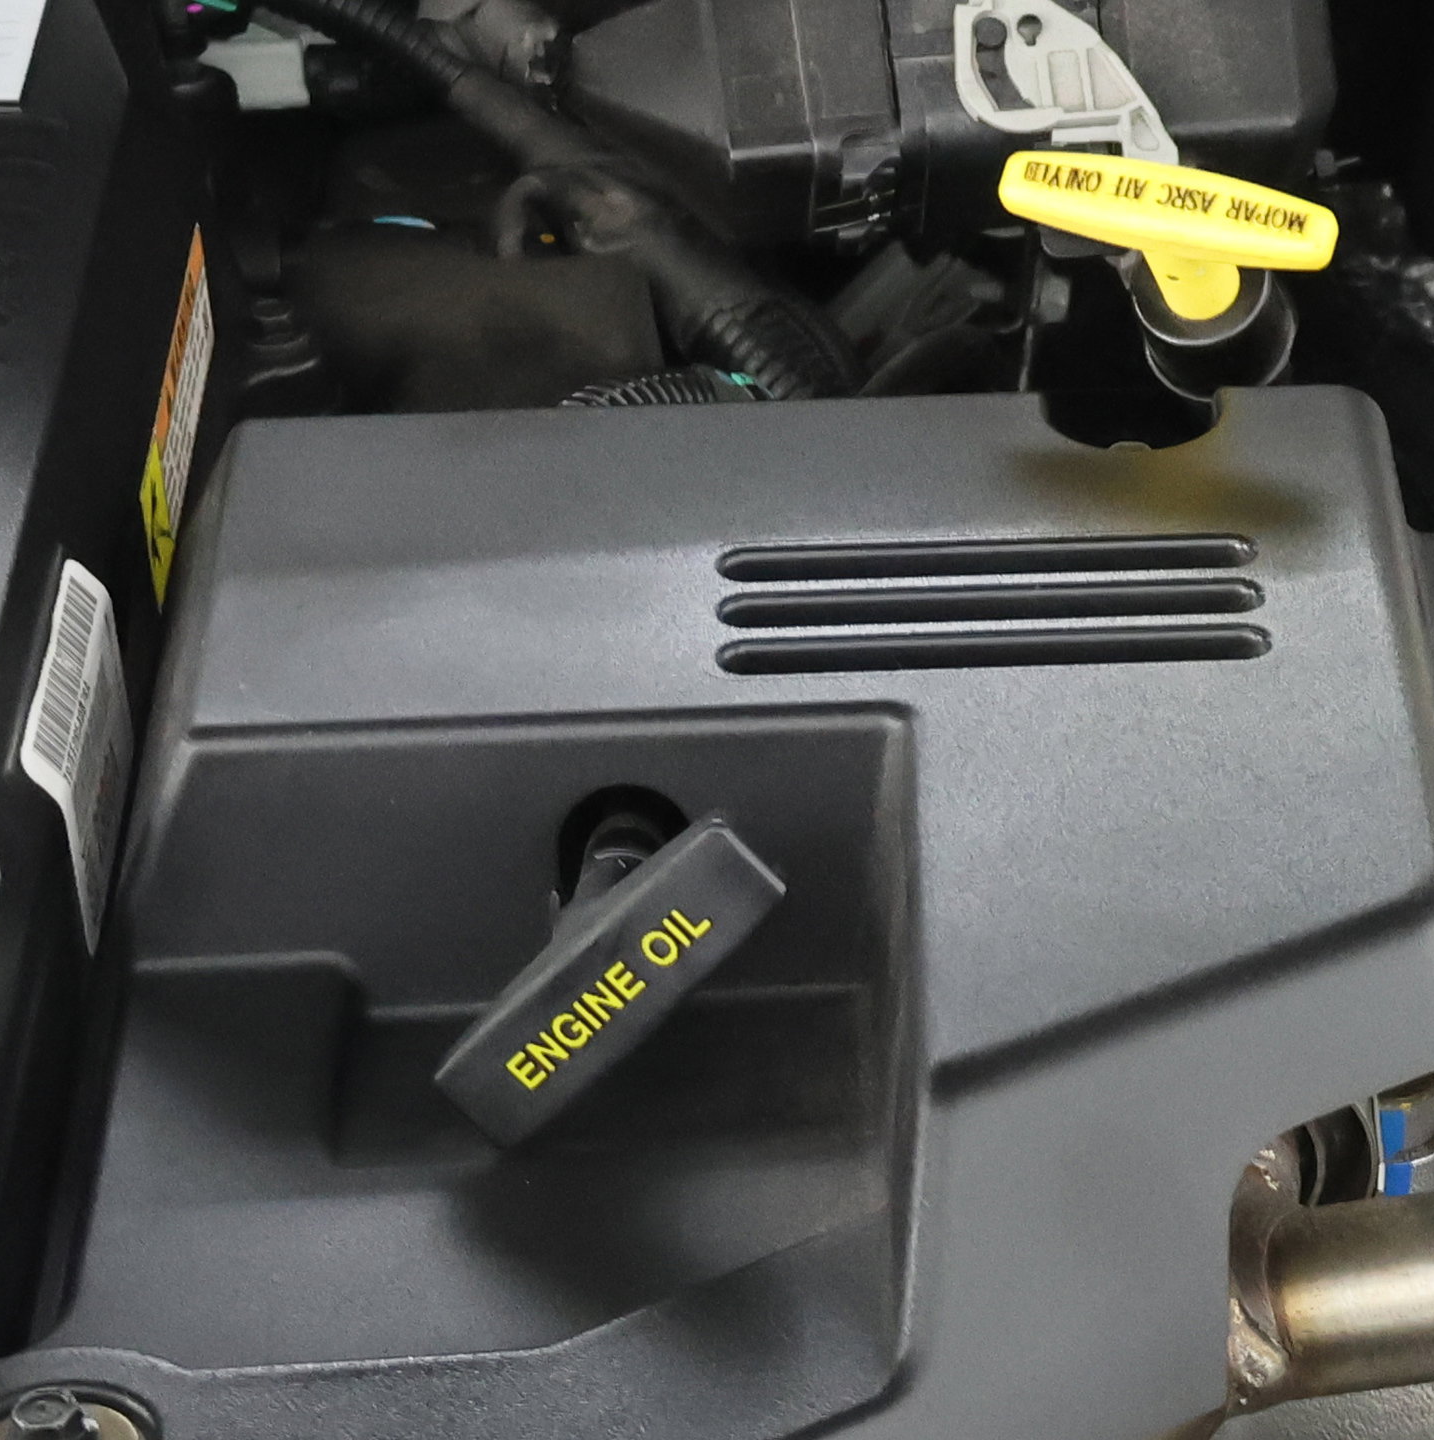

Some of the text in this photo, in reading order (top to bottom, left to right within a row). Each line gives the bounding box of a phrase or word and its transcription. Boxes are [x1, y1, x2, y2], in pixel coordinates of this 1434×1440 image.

[1226, 197, 1310, 235] MOPAR
[504, 908, 713, 1092] ENGINE OIL
